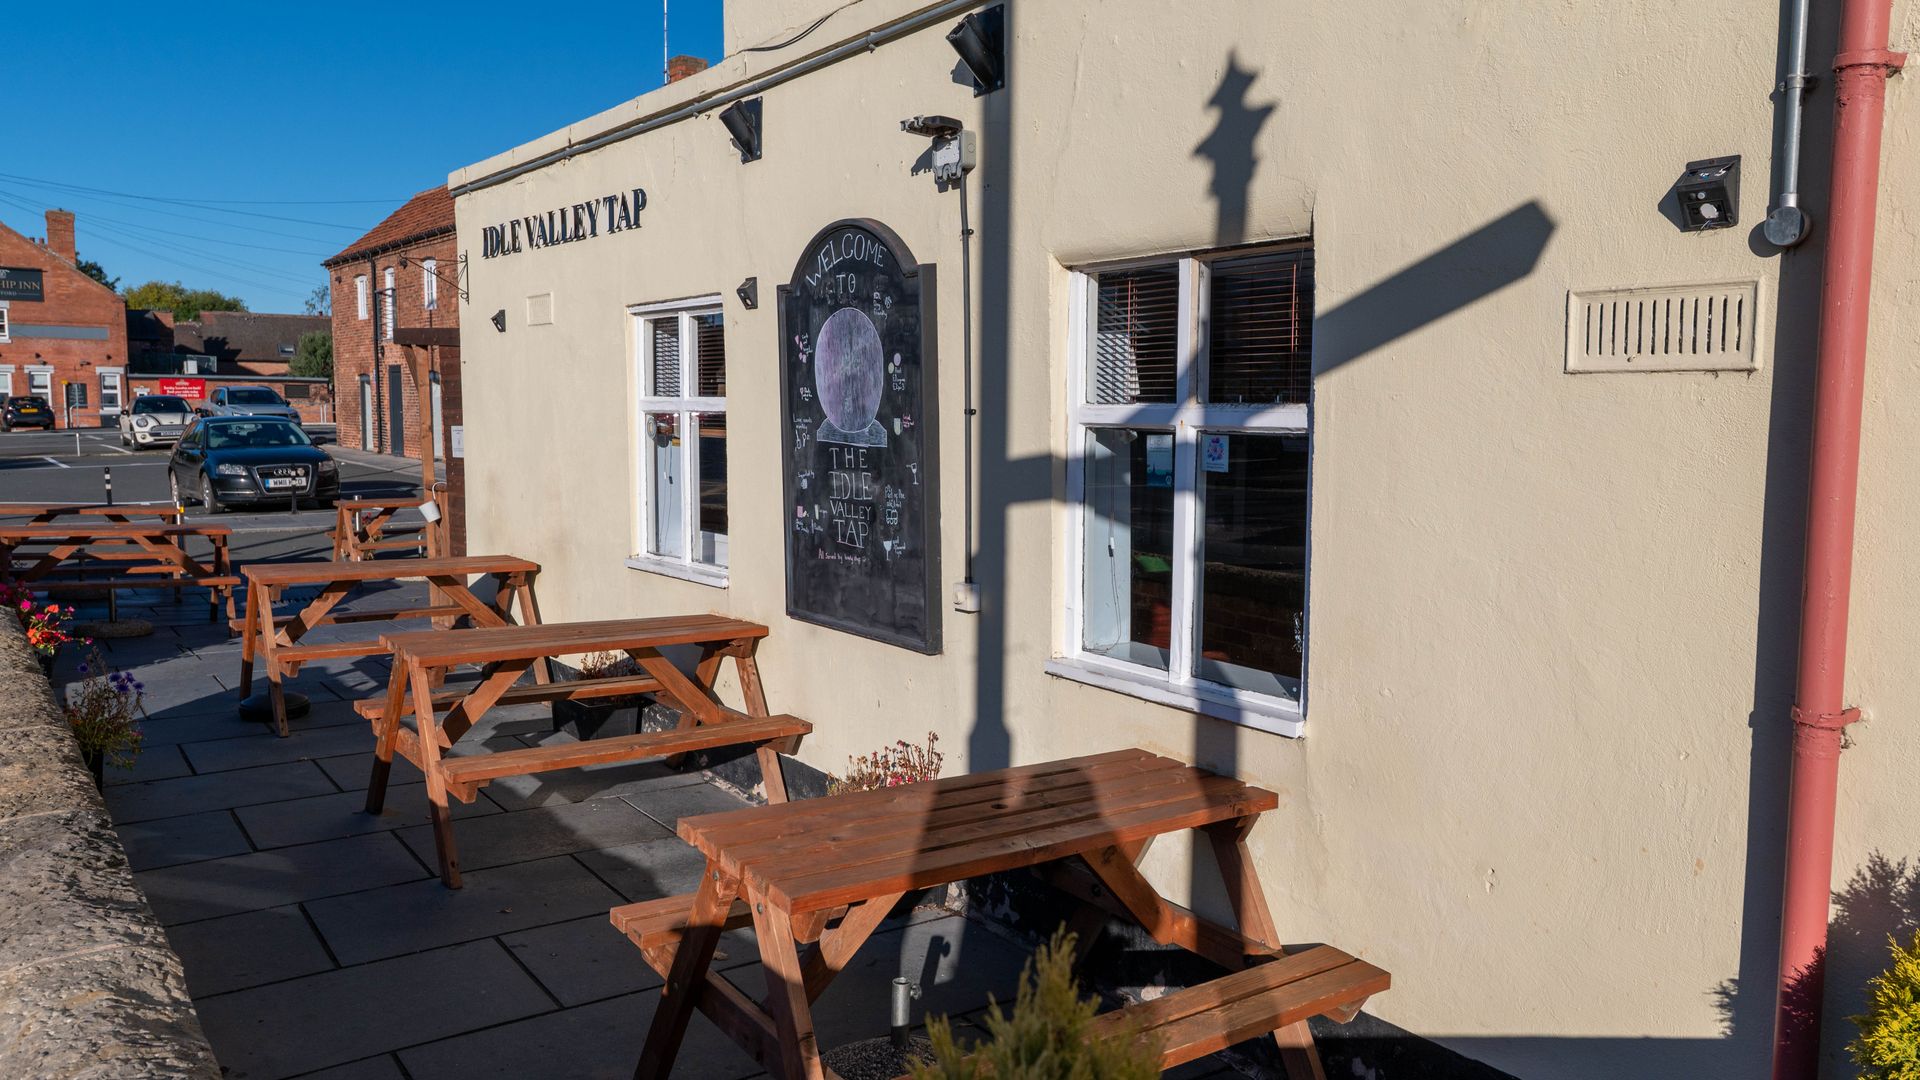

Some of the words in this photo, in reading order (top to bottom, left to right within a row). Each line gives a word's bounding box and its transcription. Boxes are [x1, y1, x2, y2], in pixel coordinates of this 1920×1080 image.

[482, 219, 521, 259] IDLE
[523, 198, 600, 250] VALLEY
[602, 187, 647, 235] TAP
[805, 233, 887, 287] WELCOME
[19, 280, 40, 290] INN
[836, 273, 856, 294] TO
[828, 447, 868, 469] THE
[828, 471, 873, 500] IDLE
[829, 500, 872, 519] VALLEY
[832, 519, 869, 548] TAP
